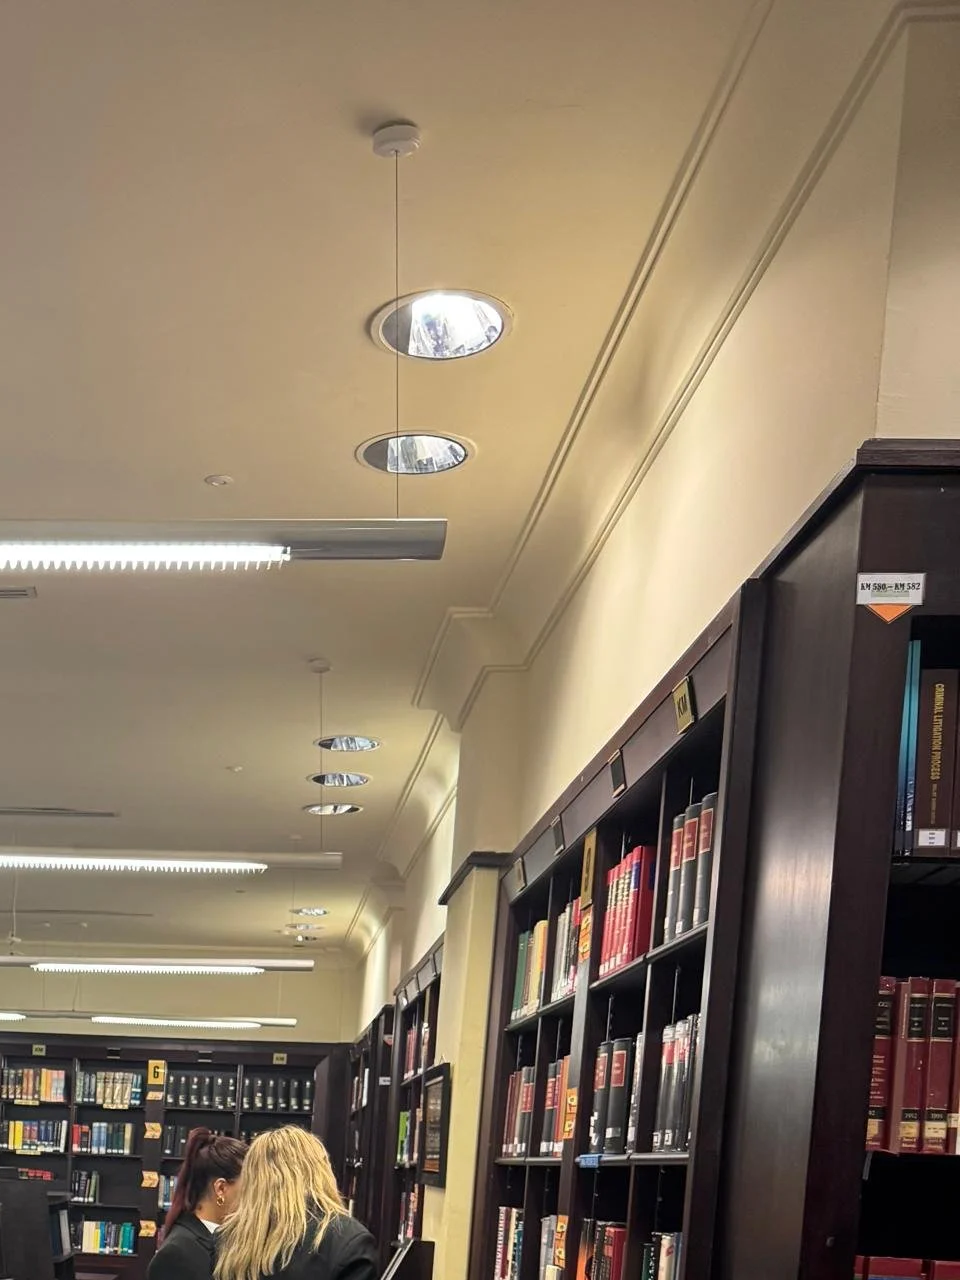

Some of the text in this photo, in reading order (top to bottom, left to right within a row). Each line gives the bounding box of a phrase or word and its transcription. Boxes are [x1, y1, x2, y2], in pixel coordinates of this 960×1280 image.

[860, 583, 871, 591] KM
[894, 583, 905, 591] KM
[906, 582, 921, 591] 582
[934, 683, 945, 713] CRIMINAL
[931, 715, 943, 750] LITIGATION
[930, 751, 942, 780] PROCESS
[153, 1065, 160, 1079] 6
